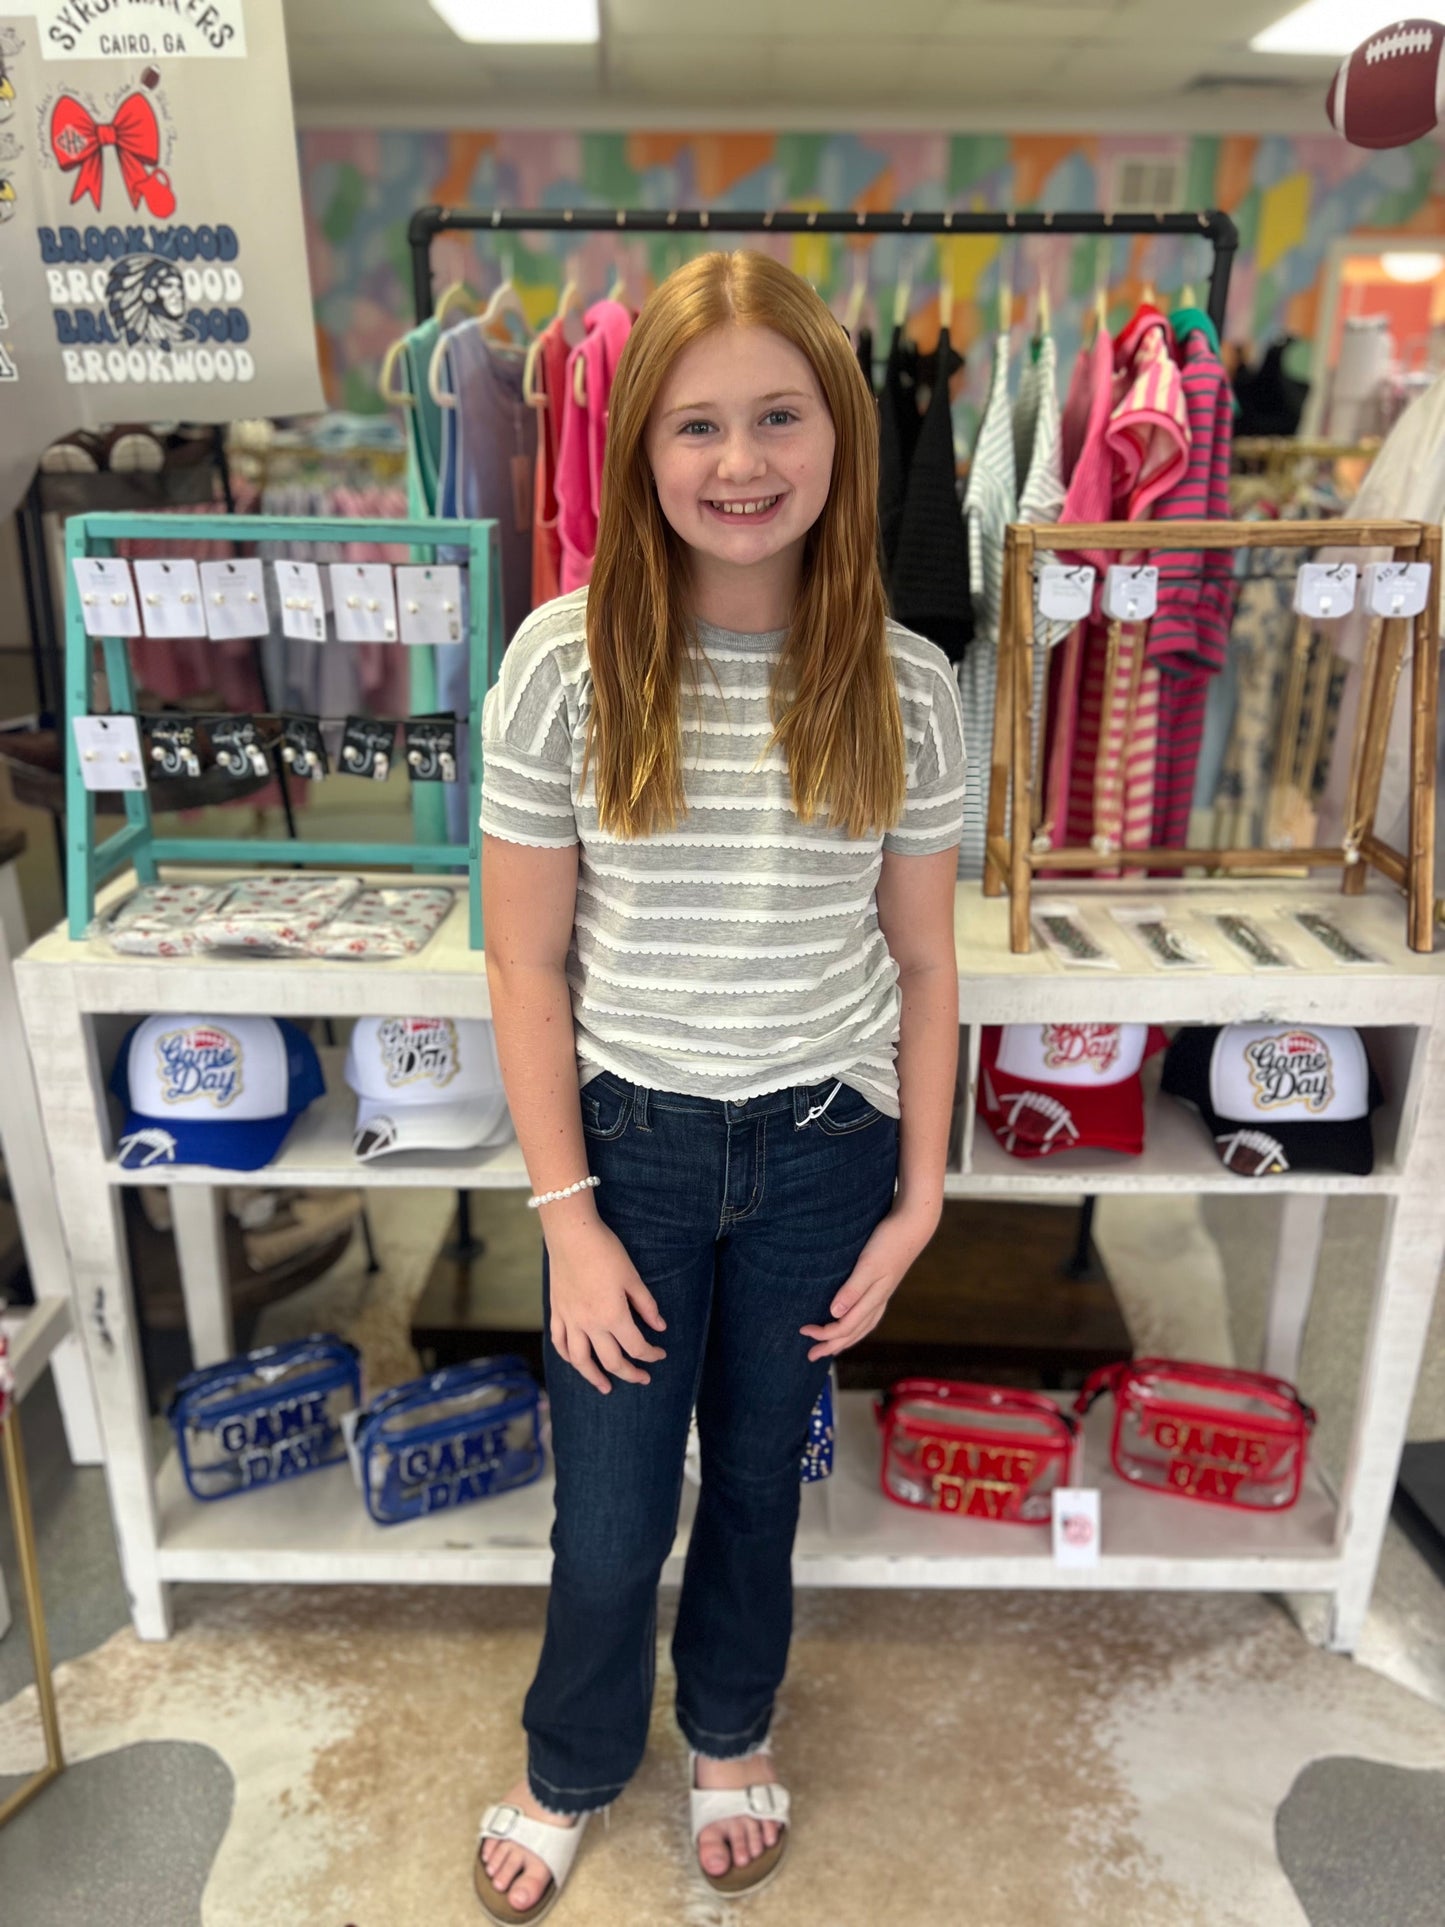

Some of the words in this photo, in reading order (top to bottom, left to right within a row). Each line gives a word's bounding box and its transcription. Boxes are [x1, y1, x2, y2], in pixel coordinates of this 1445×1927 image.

[99, 34, 156, 55] CAIRO,
[163, 33, 186, 53] GA
[38, 225, 239, 263] BROOKWOOD
[62, 349, 255, 383] BROOKWOOD
[160, 1034, 237, 1076] Game
[391, 1044, 451, 1082] Day
[1051, 1029, 1117, 1070] Day
[1250, 1042, 1327, 1081] Game
[167, 1062, 235, 1102] Day
[1261, 1067, 1327, 1107] Day
[216, 1392, 329, 1452] GAME
[239, 1434, 324, 1487] DAY
[399, 1423, 512, 1484] GAME
[917, 1437, 1037, 1484] GAME
[420, 1461, 505, 1514] DAY
[931, 1473, 1020, 1519] DAY
